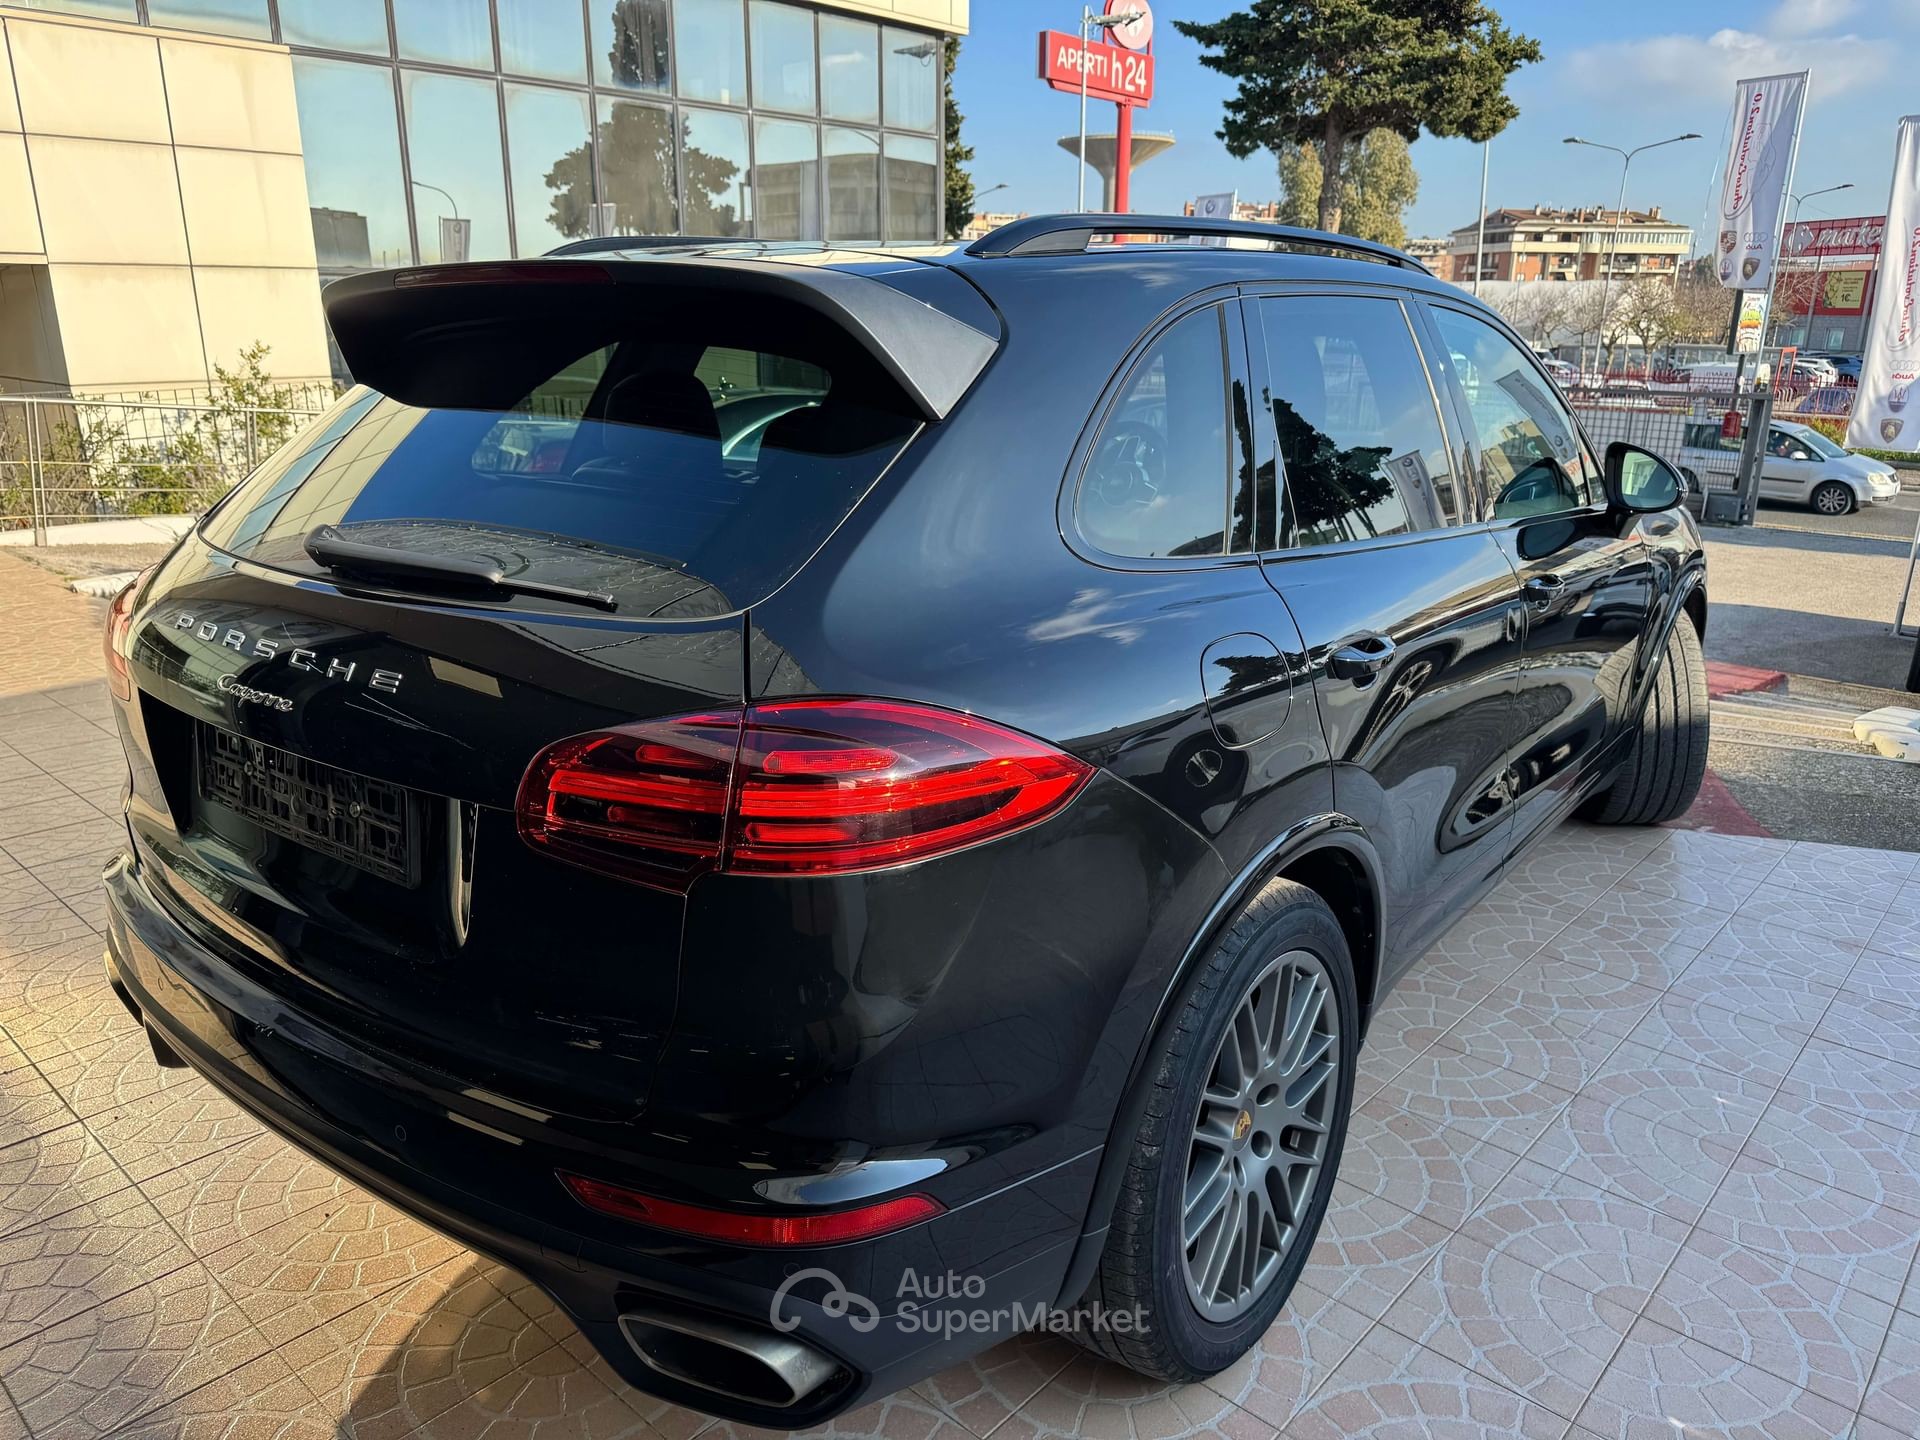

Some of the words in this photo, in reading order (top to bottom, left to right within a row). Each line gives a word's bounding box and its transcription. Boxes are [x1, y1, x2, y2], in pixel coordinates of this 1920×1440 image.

[1056, 45, 1107, 78] APERTI
[1816, 220, 1883, 248] marke
[174, 613, 403, 693] PORSCHE
[217, 673, 293, 712] Cayenne
